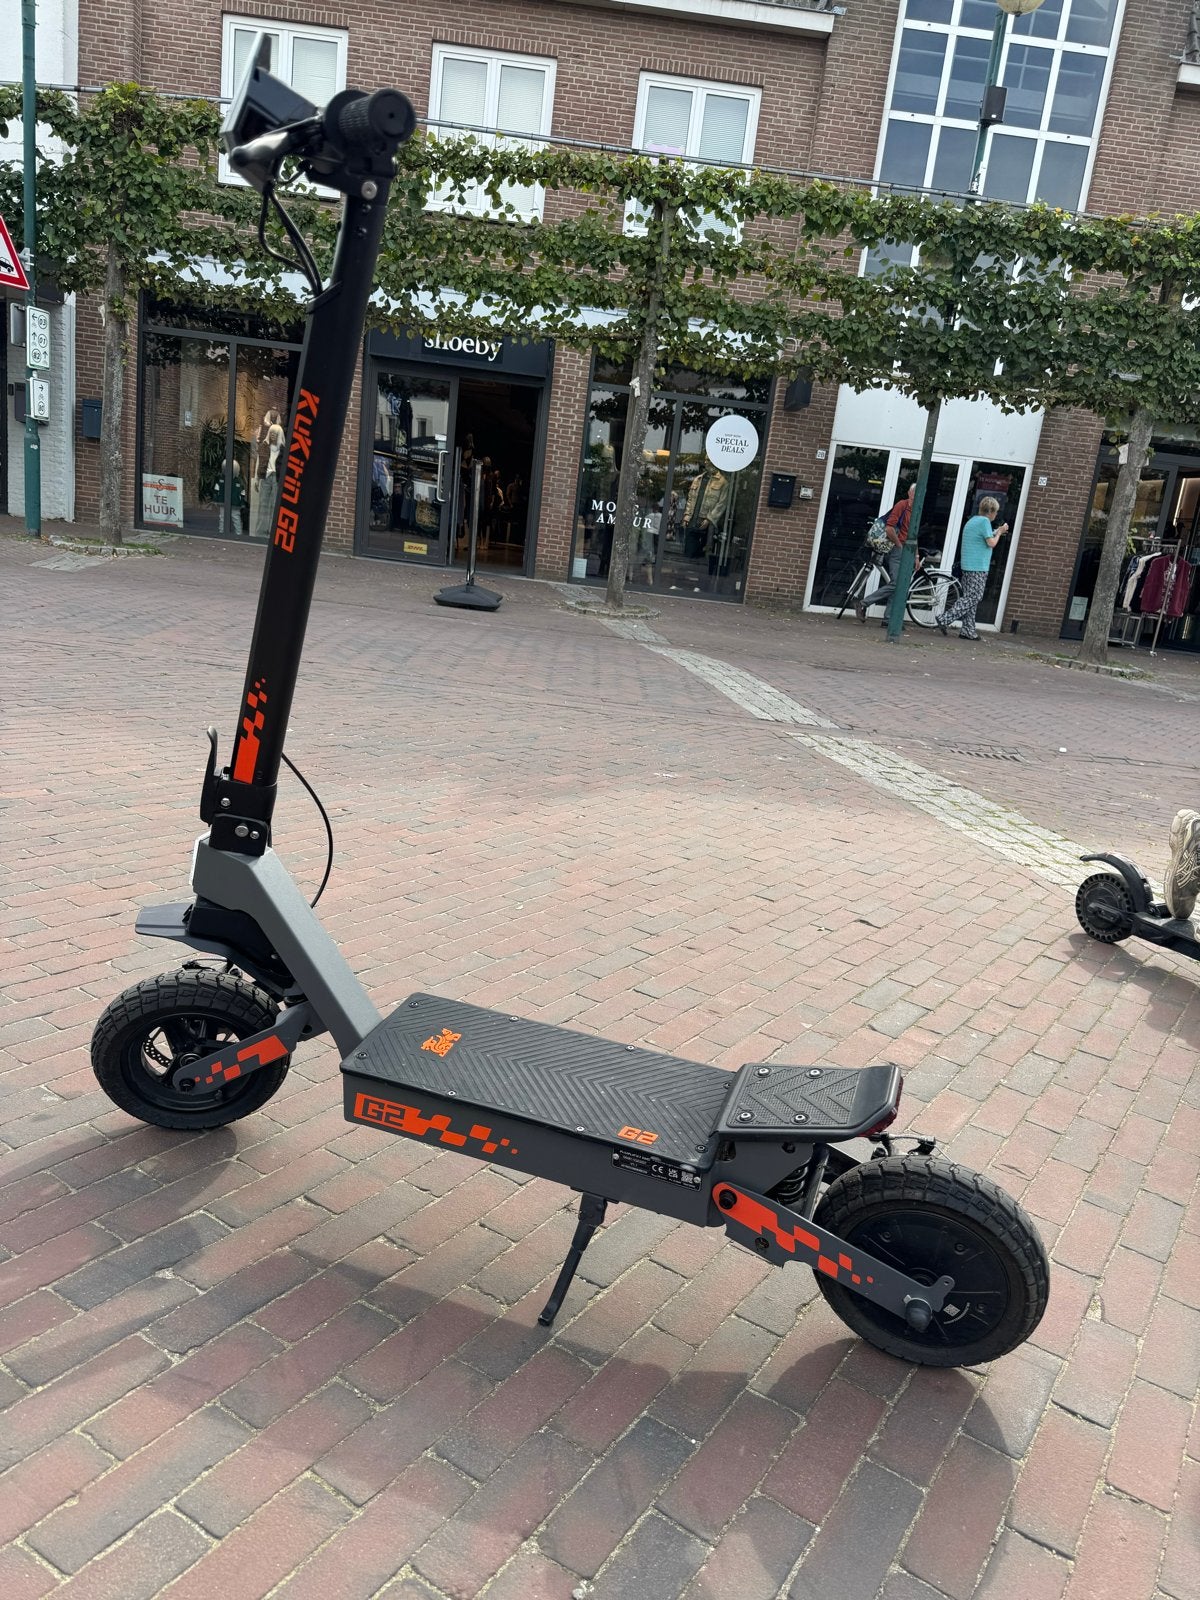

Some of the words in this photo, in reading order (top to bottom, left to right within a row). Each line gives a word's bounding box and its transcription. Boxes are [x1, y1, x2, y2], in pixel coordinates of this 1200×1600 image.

[715, 436, 749, 447] SPECIAL
[721, 445, 746, 454] DEALS
[154, 494, 168, 505] TE
[144, 504, 176, 516] HUUR
[596, 512, 652, 529] AMUR
[274, 506, 298, 553] G2
[362, 1098, 406, 1127] G2
[617, 1125, 659, 1145] G2
